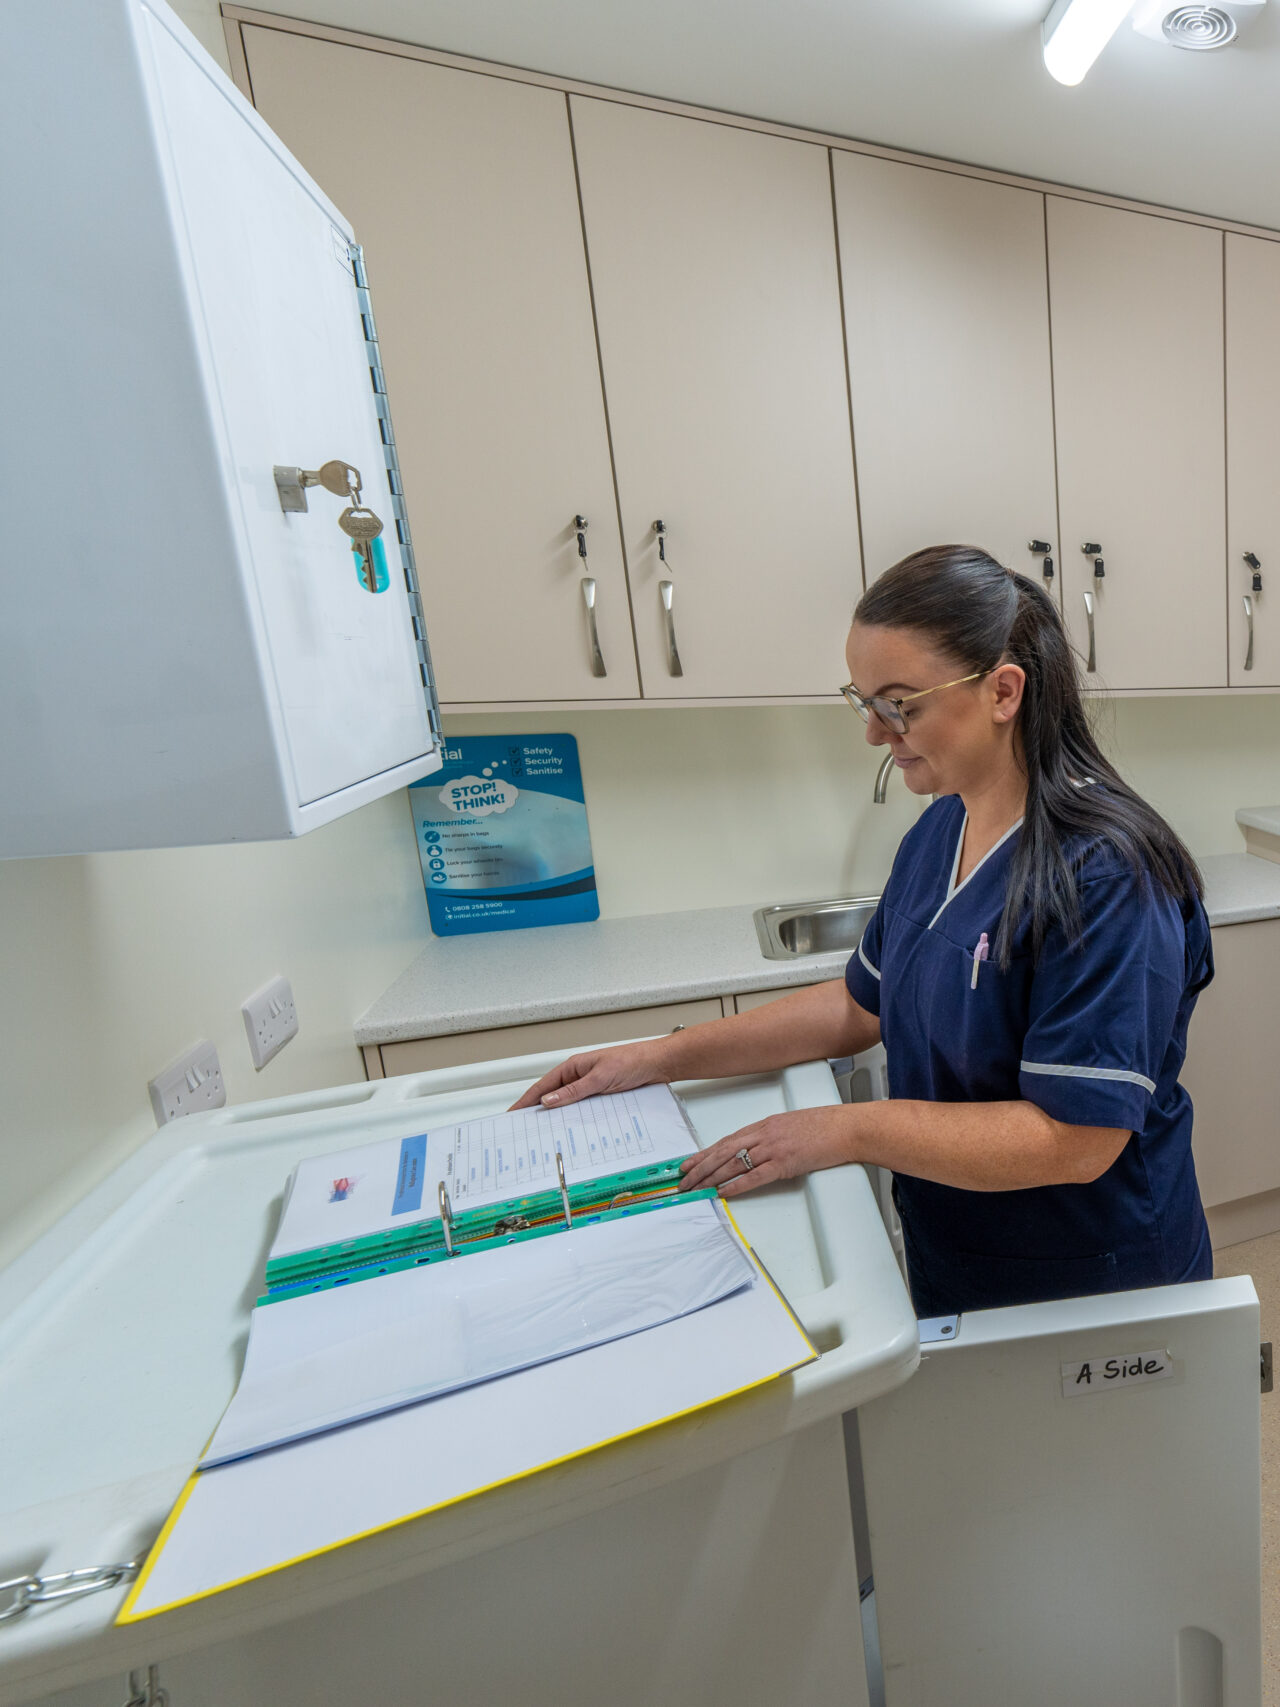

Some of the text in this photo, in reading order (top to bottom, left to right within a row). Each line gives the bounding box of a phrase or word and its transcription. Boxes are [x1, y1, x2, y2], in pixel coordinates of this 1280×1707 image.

[523, 747, 553, 755] Safety
[525, 757, 563, 766] Security
[526, 767, 563, 776] Sanitise
[451, 782, 497, 799] STOP!
[453, 793, 505, 811] THINK!
[1076, 1357, 1164, 1385] A Side
